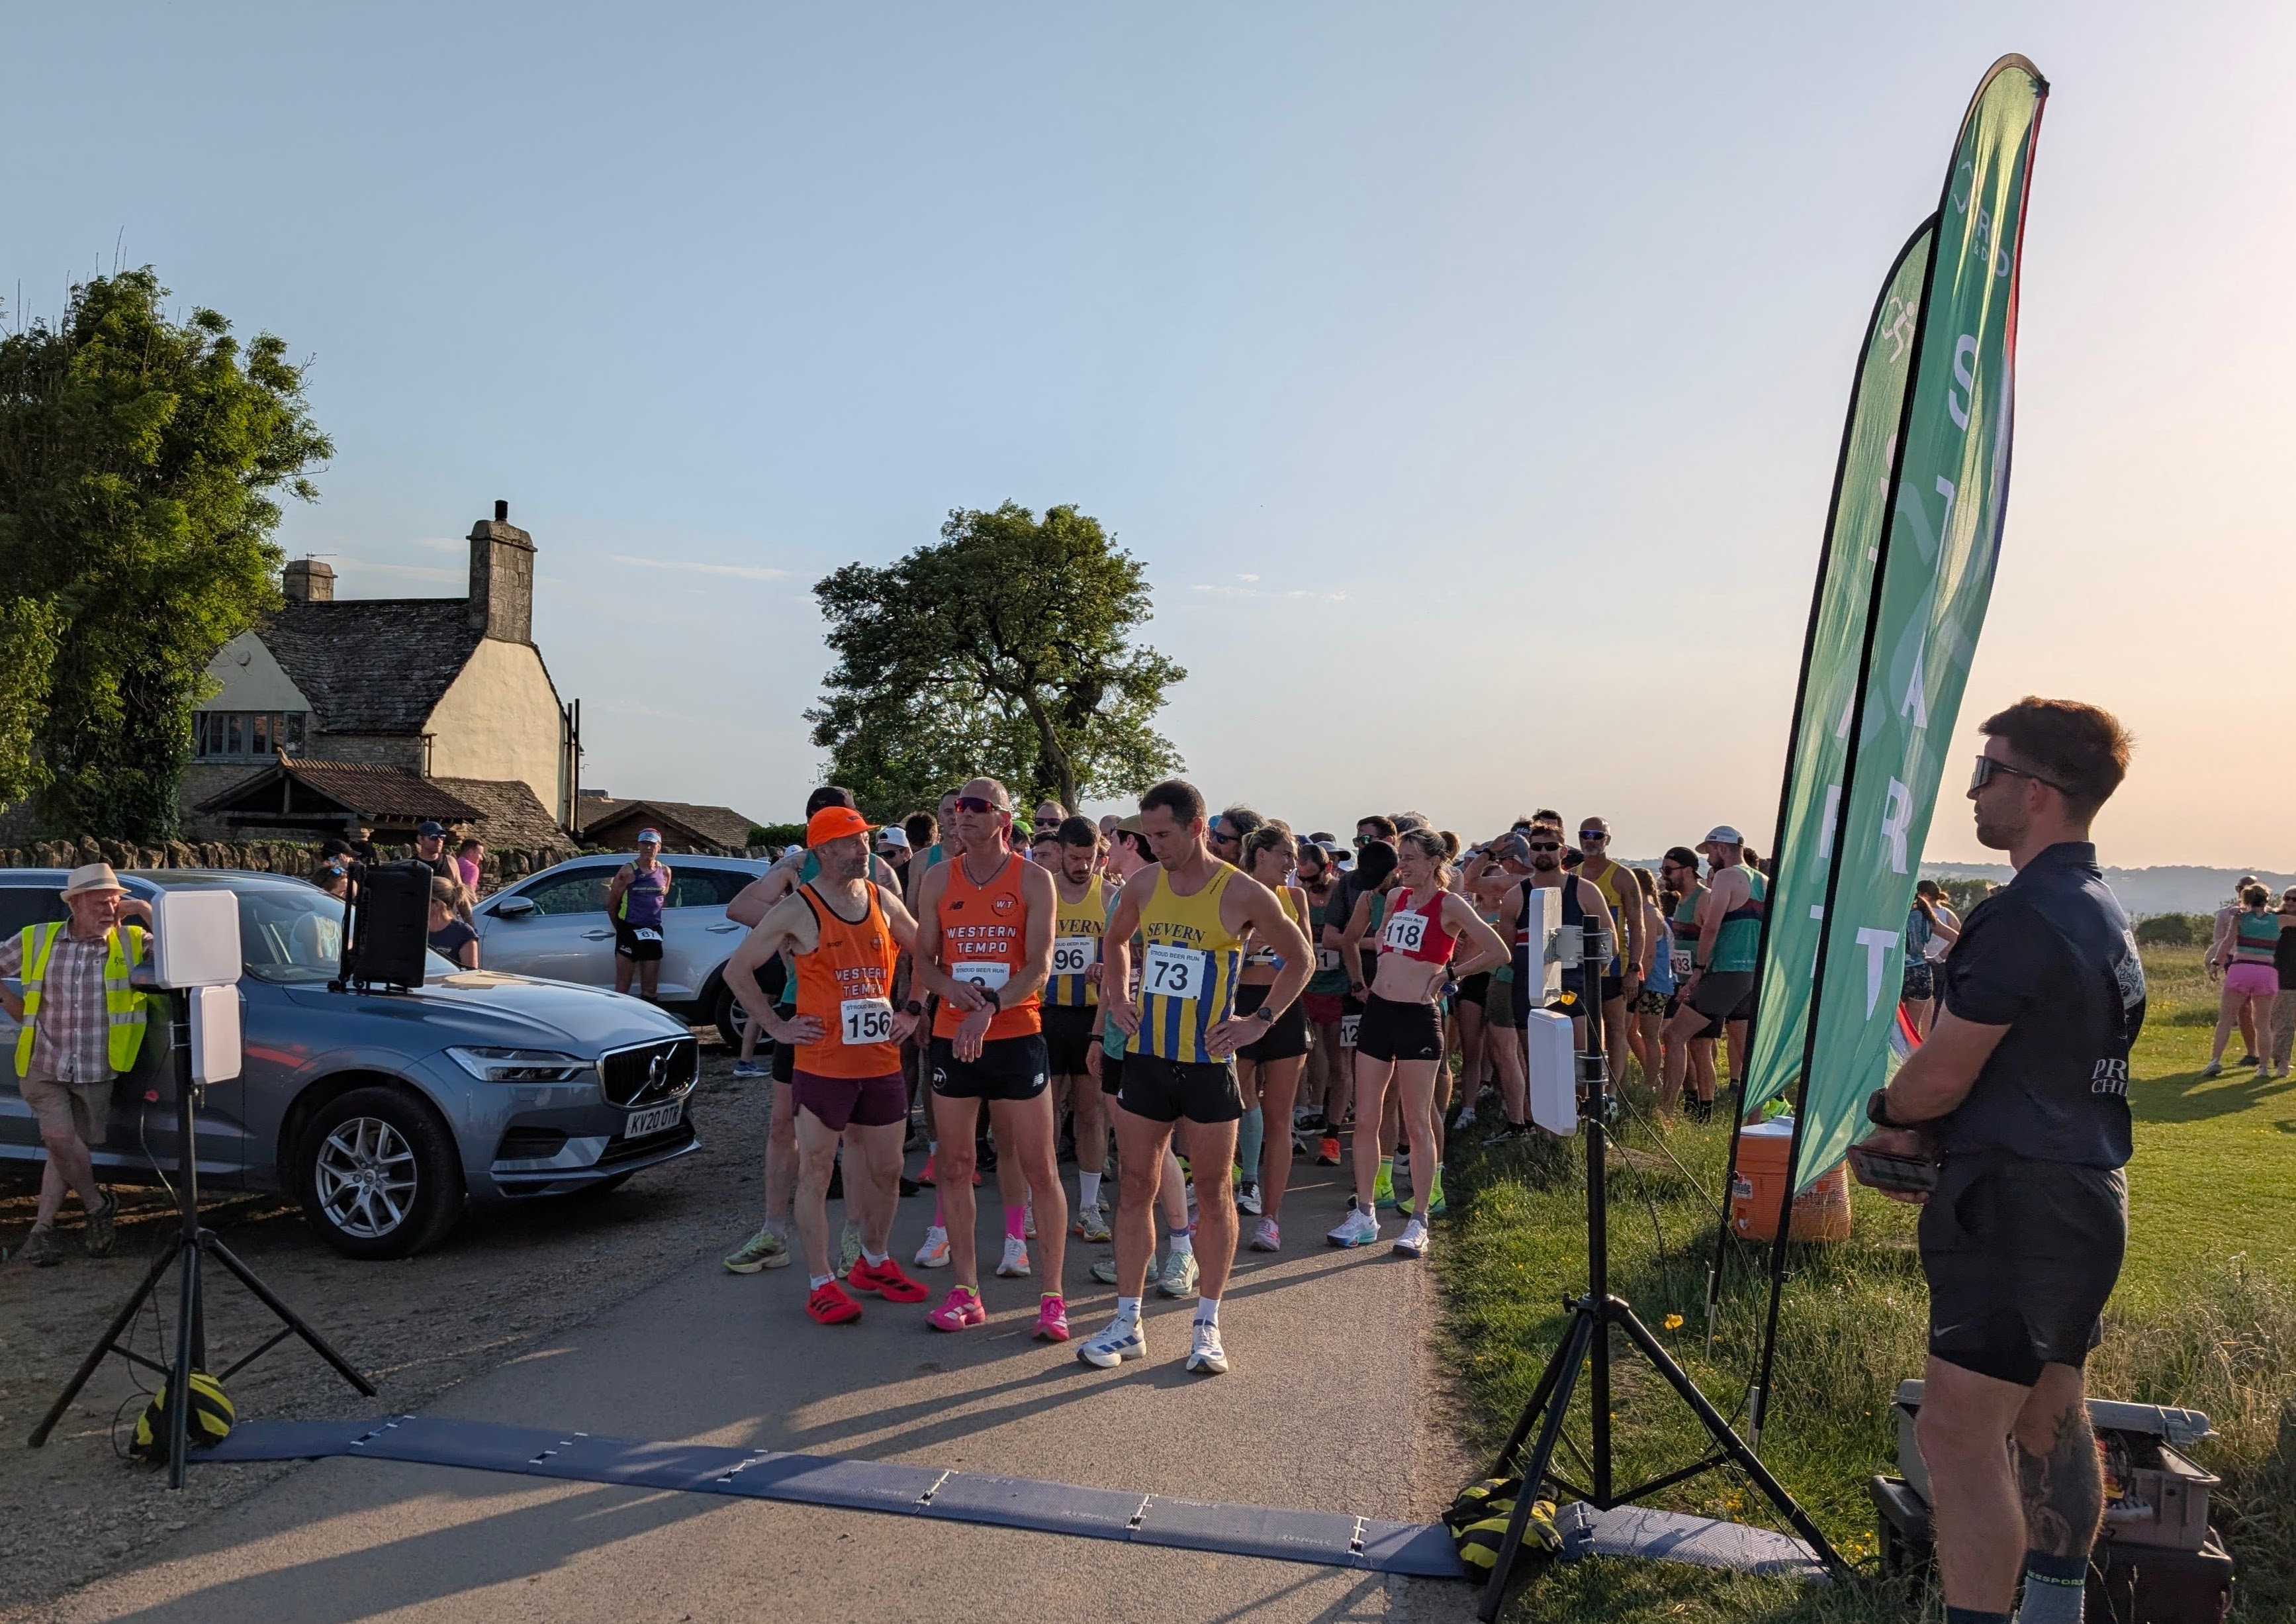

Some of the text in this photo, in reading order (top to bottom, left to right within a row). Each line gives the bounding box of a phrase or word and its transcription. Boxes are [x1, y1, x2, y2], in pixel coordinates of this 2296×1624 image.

[947, 926, 1017, 939] WESTERN
[1058, 919, 1105, 934] VERN
[1148, 922, 1207, 943] SEVERN
[1387, 923, 1420, 945] 118
[957, 941, 1008, 953] TEMPO
[1054, 949, 1084, 970] 96
[1154, 961, 1189, 991] 73
[848, 1011, 891, 1038] 156
[631, 1105, 680, 1134] KV20 OTR
